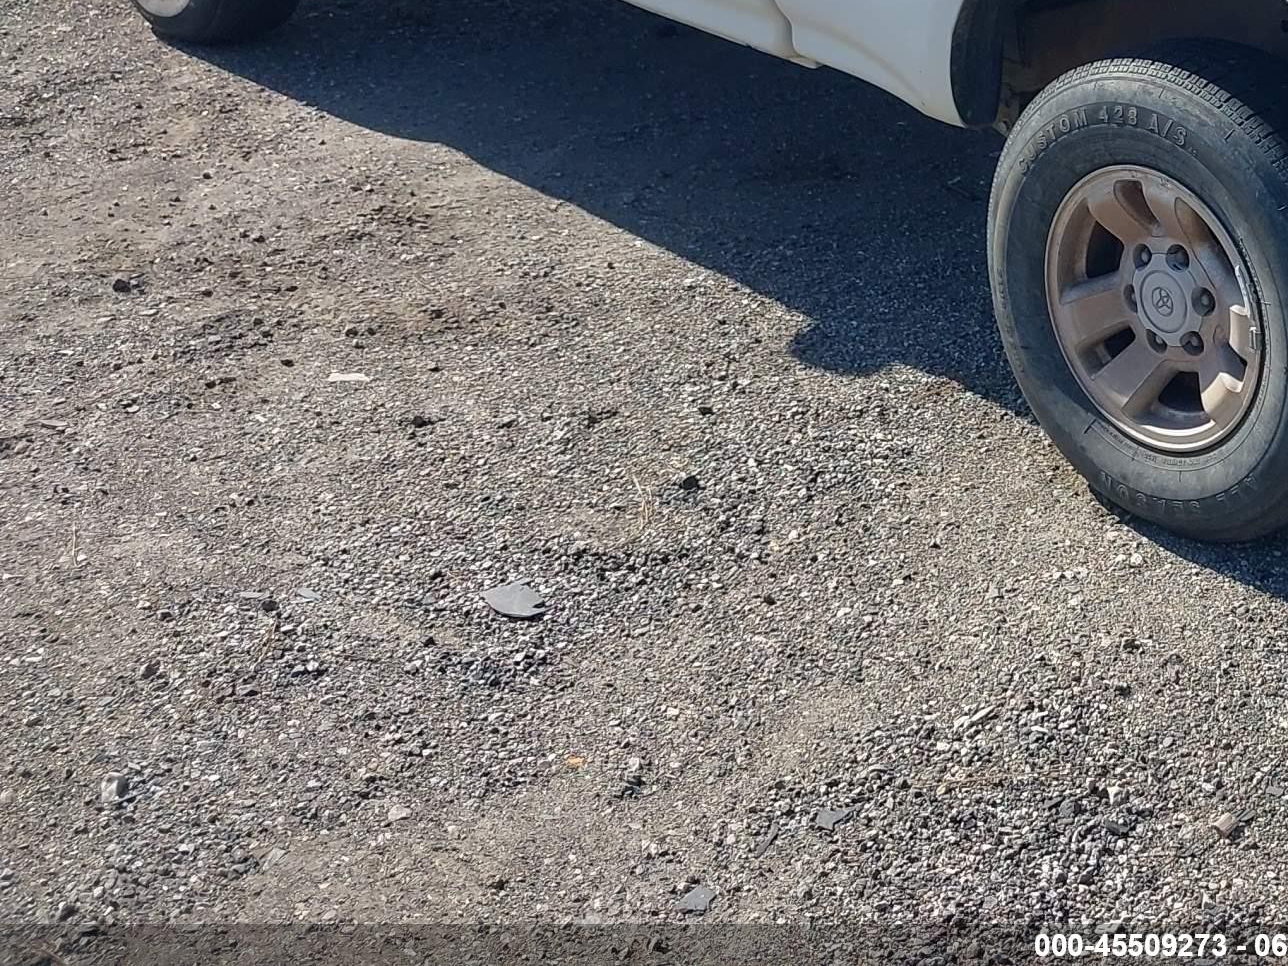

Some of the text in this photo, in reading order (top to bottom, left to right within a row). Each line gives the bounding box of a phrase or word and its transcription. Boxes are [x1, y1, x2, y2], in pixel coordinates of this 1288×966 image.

[1017, 105, 1188, 174] CUSTOM 428 A/S
